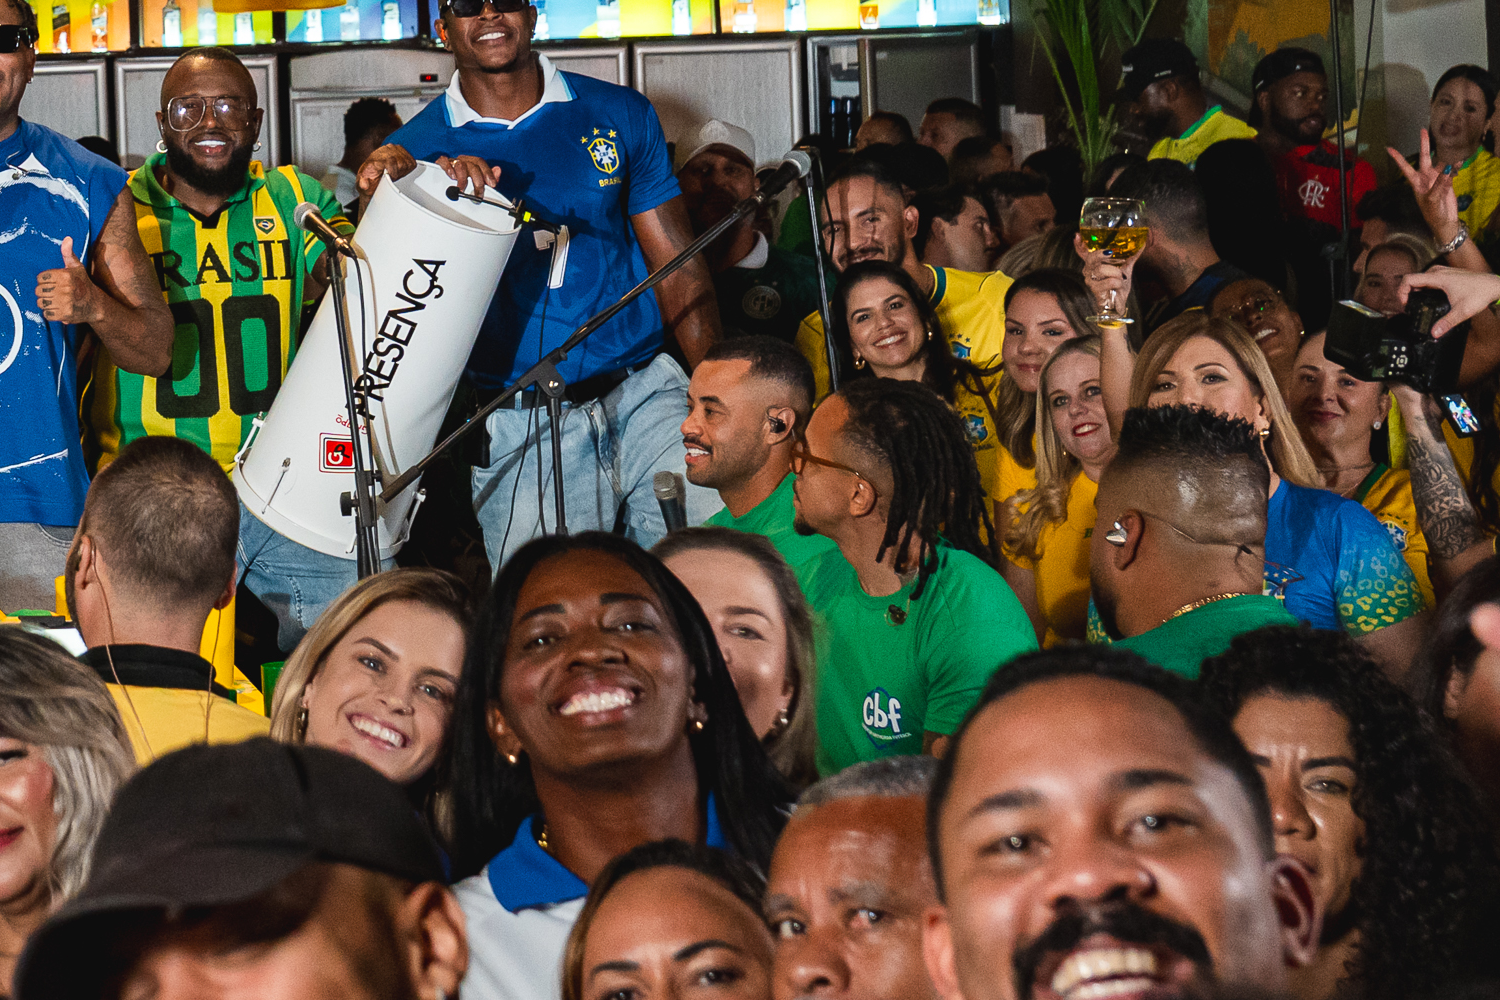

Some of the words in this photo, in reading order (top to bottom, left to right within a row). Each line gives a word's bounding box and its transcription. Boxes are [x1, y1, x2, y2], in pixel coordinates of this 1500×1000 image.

[598, 176, 623, 188] BRASIL
[151, 239, 293, 292] RASIL
[156, 293, 284, 420] 00
[862, 692, 902, 733] cbf
